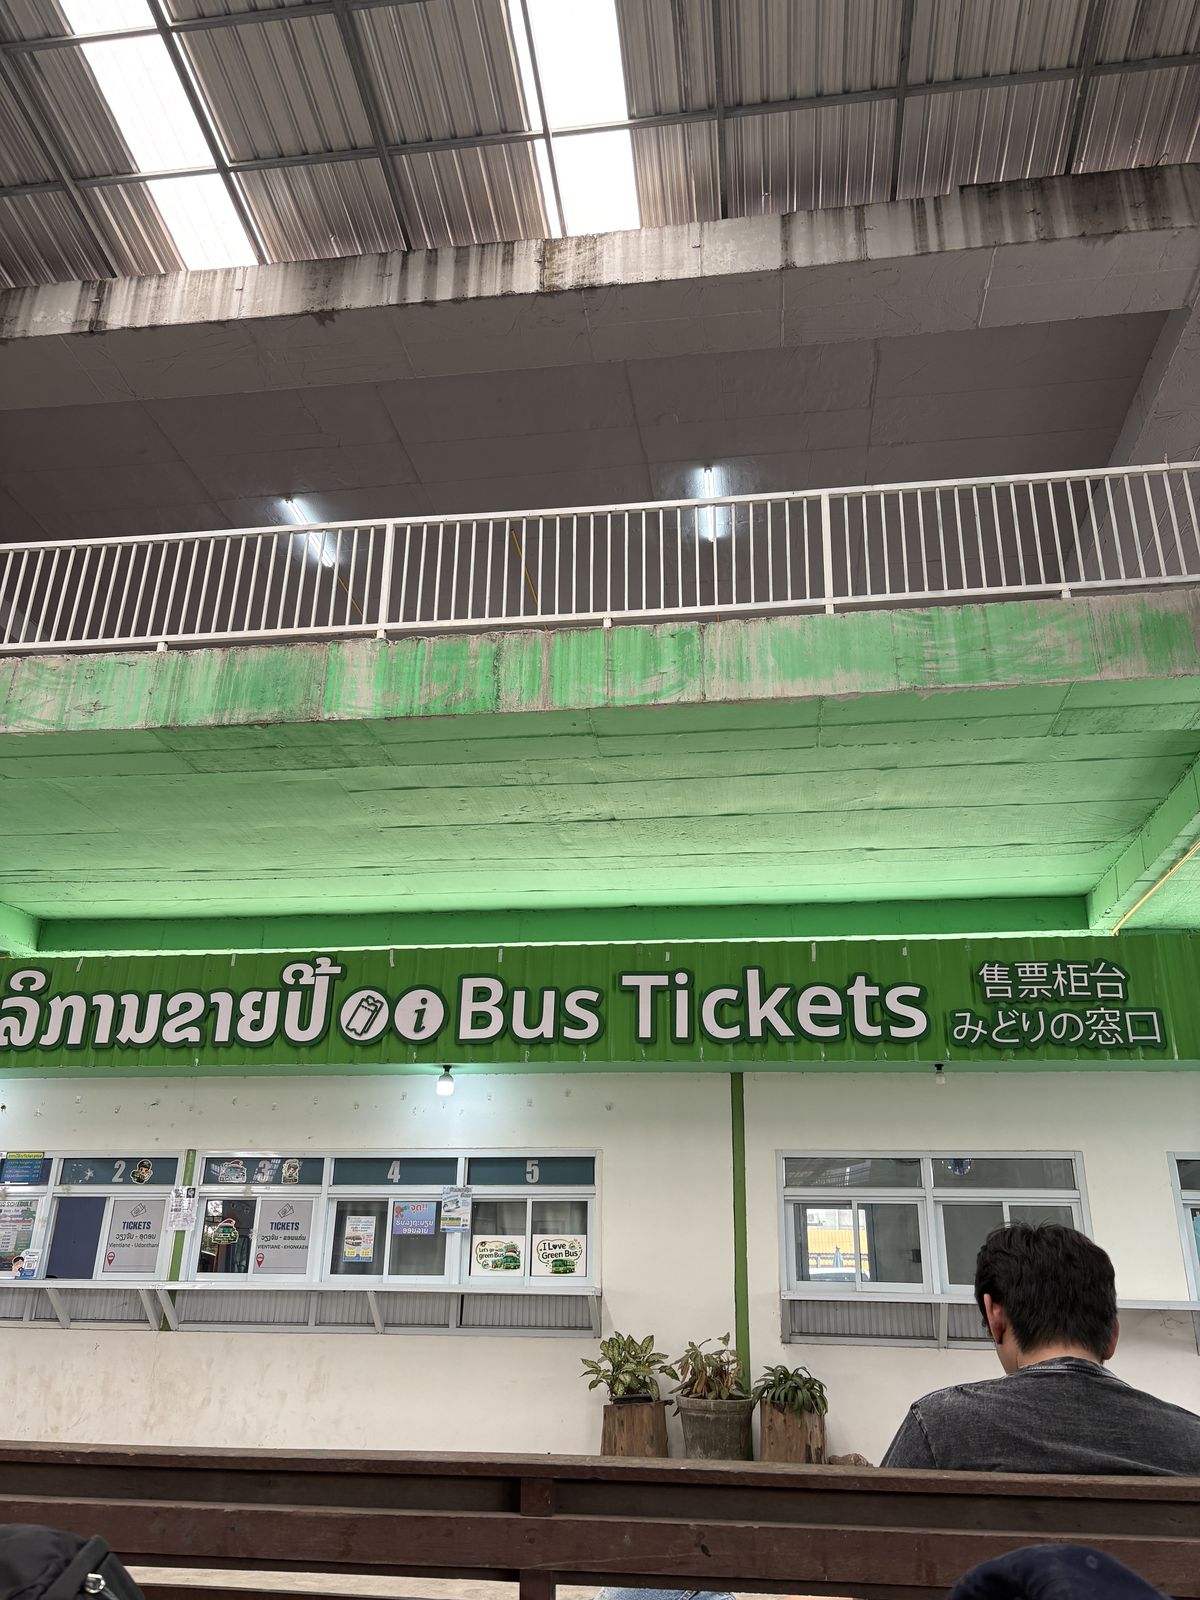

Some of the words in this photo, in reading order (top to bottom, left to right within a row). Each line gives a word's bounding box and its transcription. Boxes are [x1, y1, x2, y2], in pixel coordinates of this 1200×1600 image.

[978, 961, 1126, 999] 售票柜台
[458, 977, 601, 1041] Bus
[621, 968, 928, 1040] Tickets
[953, 1006, 1162, 1045] みどりの窓口
[112, 1160, 126, 1182] 2
[258, 1160, 271, 1183] 3
[387, 1160, 401, 1183] 4
[525, 1160, 540, 1183] 5
[122, 1221, 151, 1230] TICKETS
[270, 1222, 300, 1231] TICKETS
[541, 1251, 563, 1260] Green
[543, 1242, 547, 1251] I
